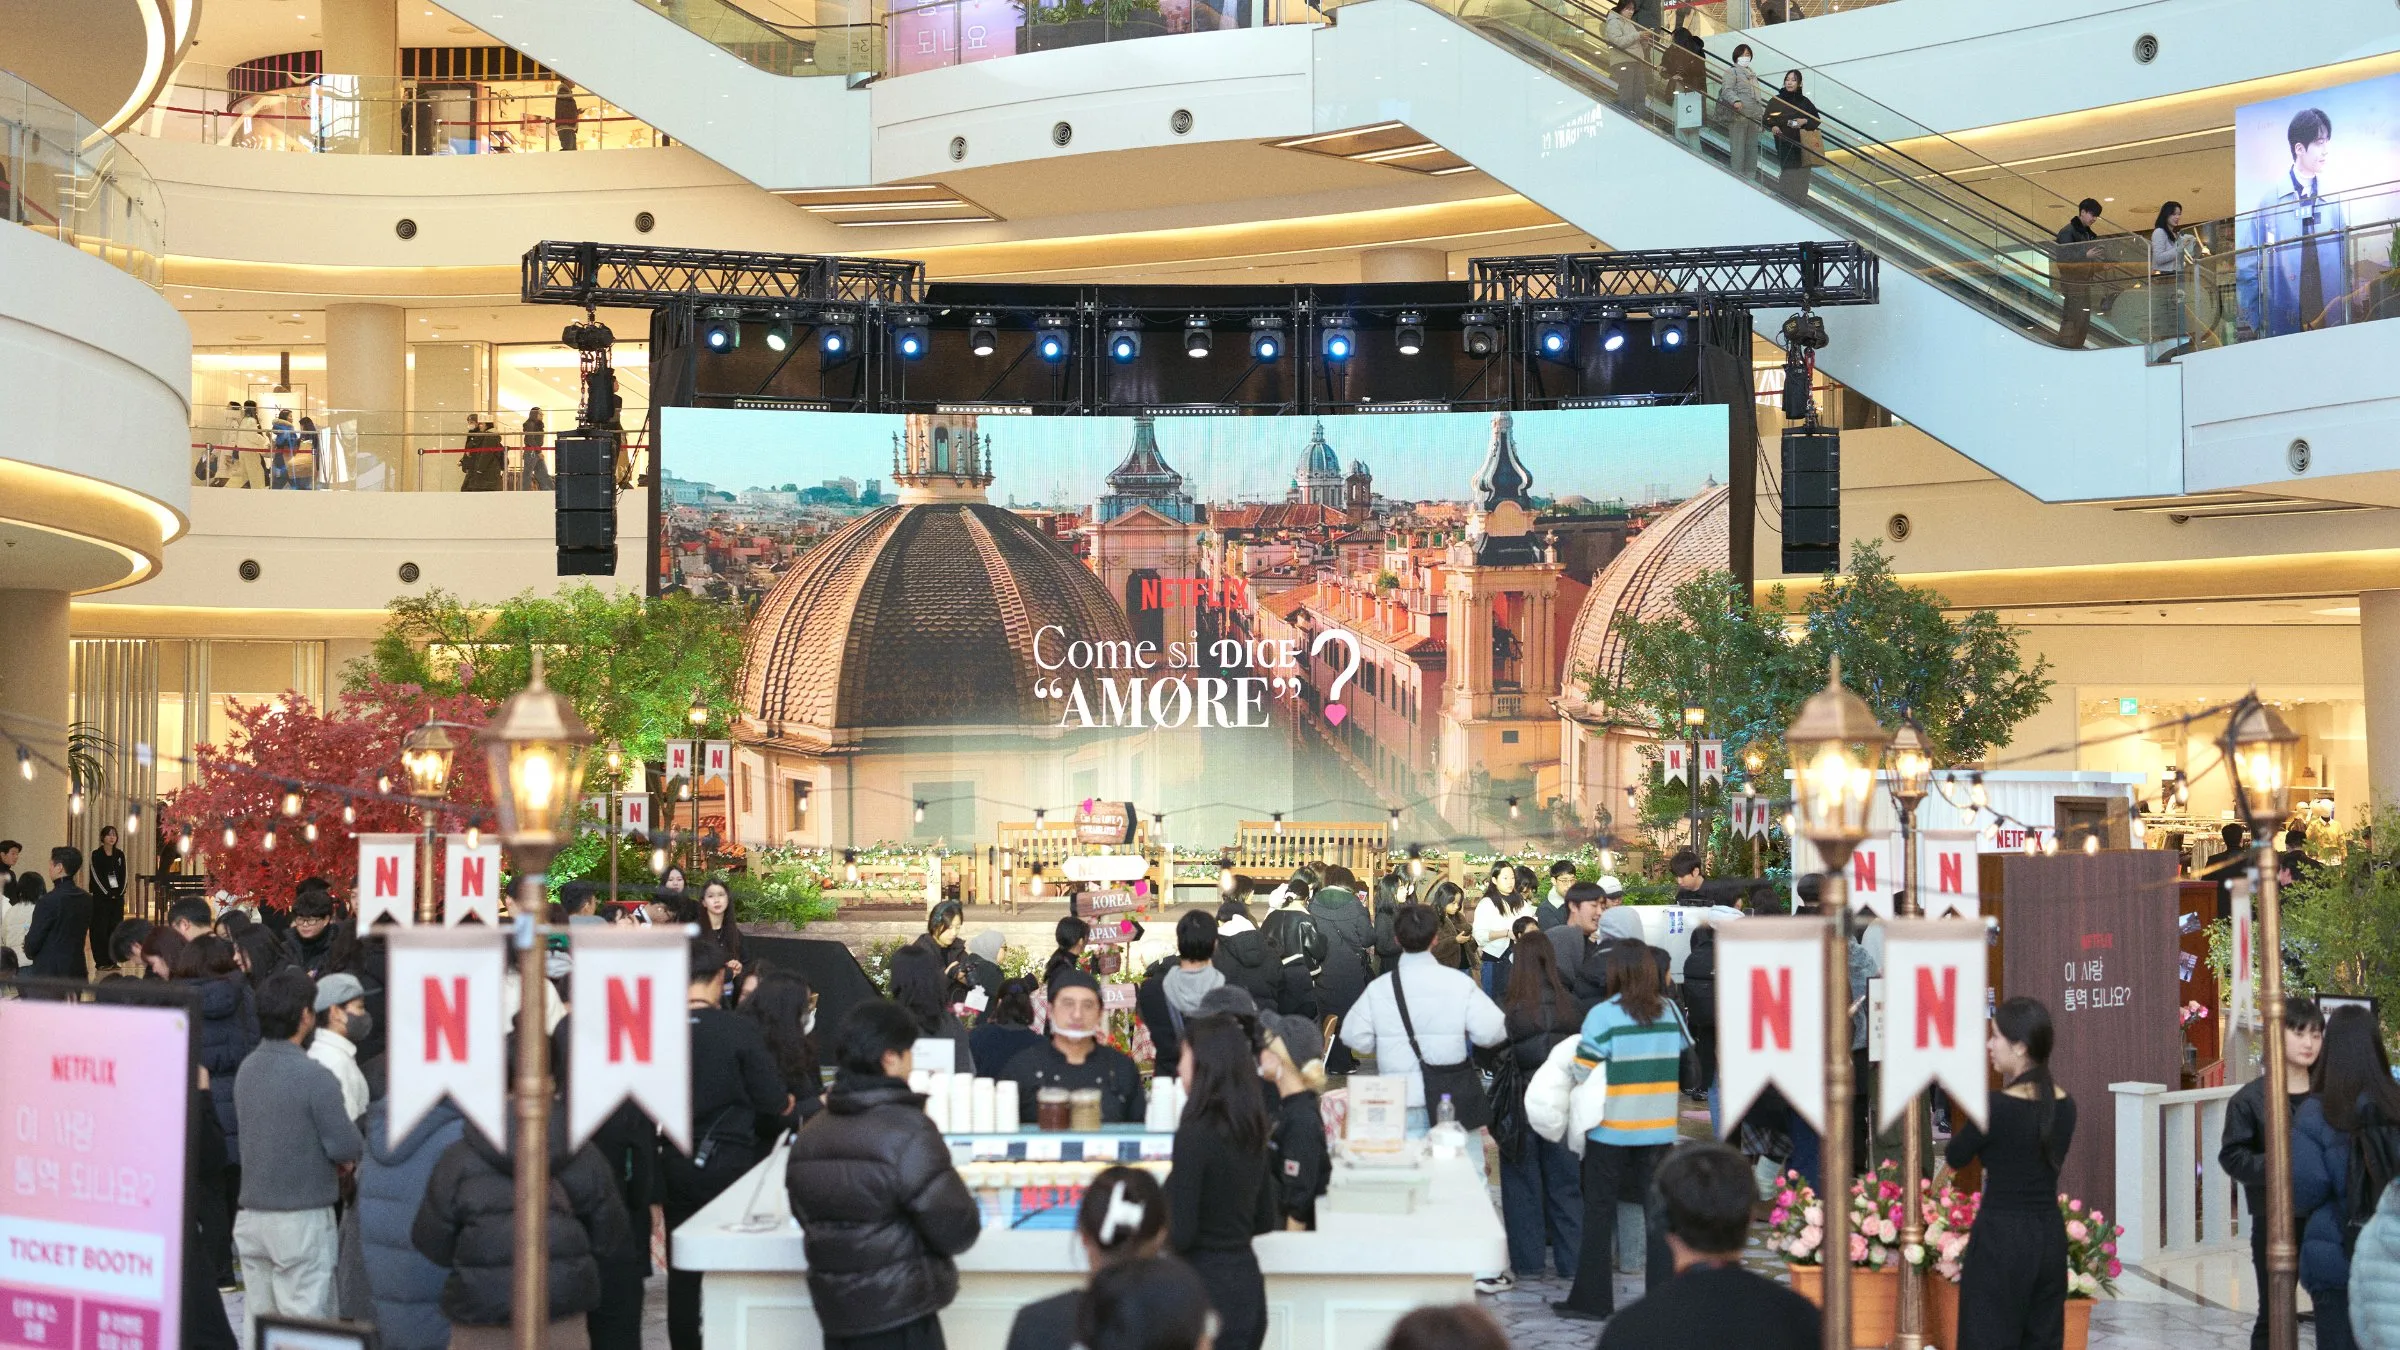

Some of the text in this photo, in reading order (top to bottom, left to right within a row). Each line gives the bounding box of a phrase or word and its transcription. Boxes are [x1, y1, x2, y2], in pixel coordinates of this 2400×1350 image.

[1141, 578, 1250, 611] NETFLIX
[1033, 624, 1158, 670] Come
[1168, 630, 1200, 669] si
[1209, 638, 1303, 669] DICE
[674, 749, 684, 768] N
[712, 750, 723, 768] N
[1670, 750, 1680, 769] N
[1705, 750, 1716, 769] N
[630, 803, 641, 822] N
[1735, 803, 1742, 822] N
[1757, 804, 1764, 824] N
[1996, 830, 2043, 851] NETFX
[375, 856, 398, 897] N
[461, 856, 485, 897] N
[1853, 851, 1876, 892] N
[1939, 852, 1962, 894] N
[1092, 893, 1132, 910] KOREA
[1088, 926, 1117, 940] APAN
[2064, 956, 2103, 982] 이 사랑
[1750, 967, 1792, 1051] N
[1916, 966, 1957, 1048] N
[2065, 986, 2131, 1011] 통역 되나요?
[424, 976, 468, 1063] N
[607, 976, 652, 1063] N
[52, 1055, 116, 1087] NETFLIX
[16, 1105, 38, 1143] 이
[1021, 1184, 1086, 1211] NETF
[9, 1236, 153, 1277] TICKET BOOTH
